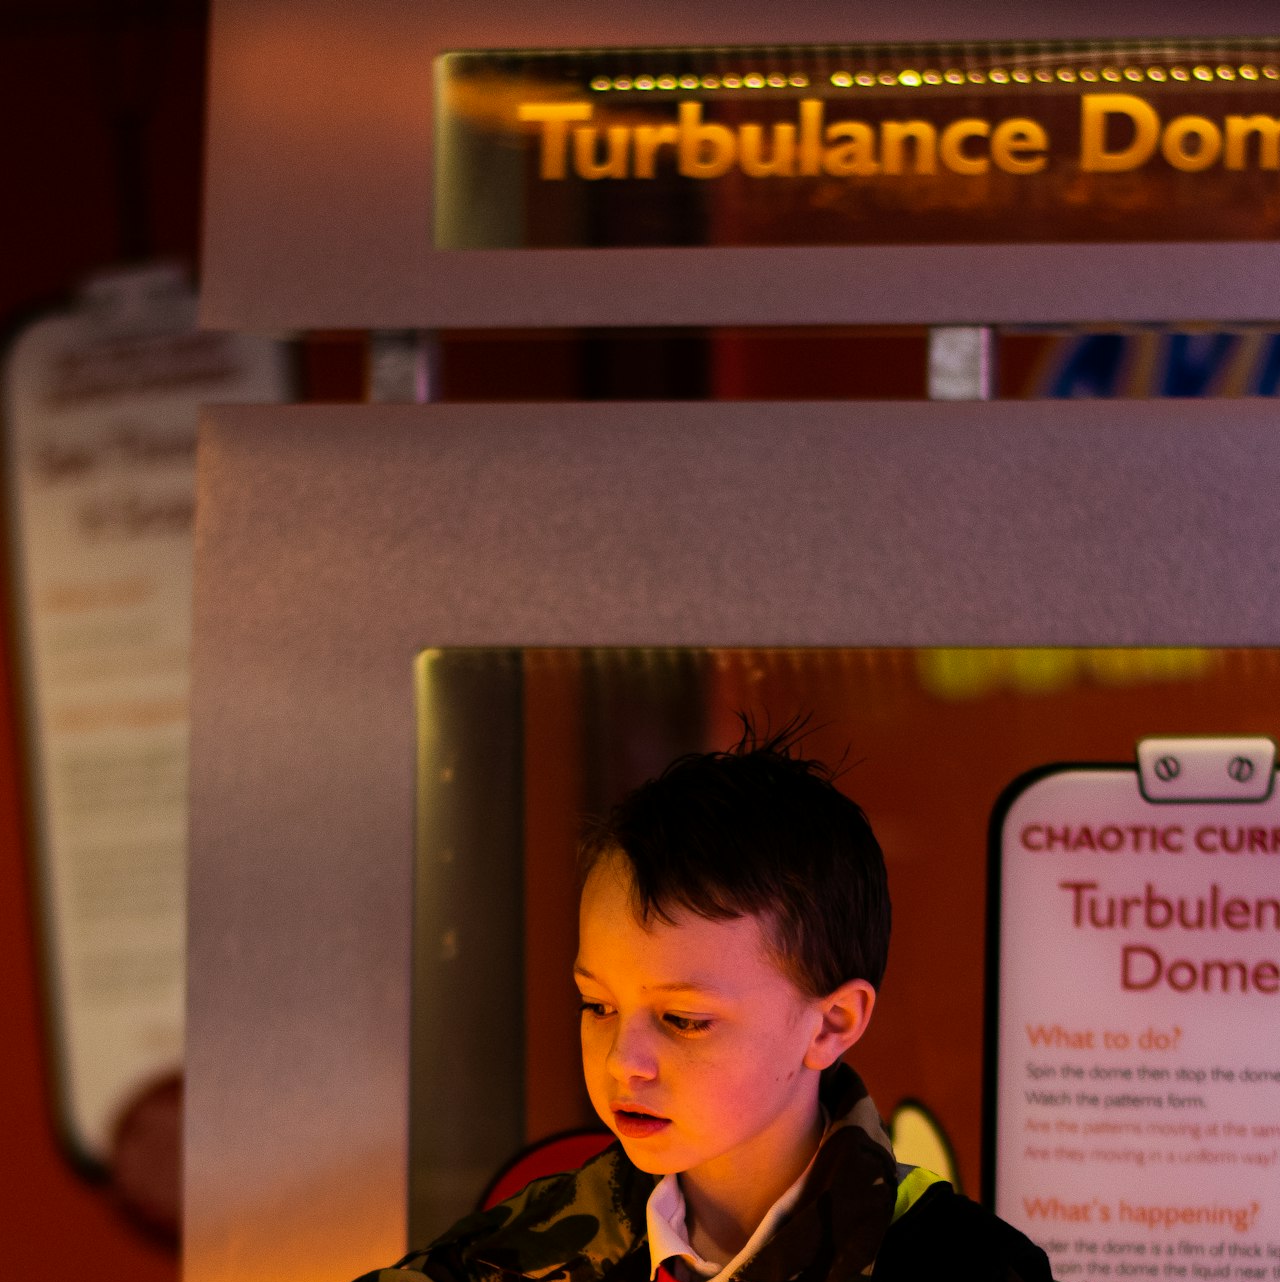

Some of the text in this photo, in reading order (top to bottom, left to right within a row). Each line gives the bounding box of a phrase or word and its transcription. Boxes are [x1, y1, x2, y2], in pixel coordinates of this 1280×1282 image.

[519, 97, 1049, 182] Turbulance
[1020, 824, 1184, 853] CHAOTIC
[1024, 1024, 1183, 1051] What to do?
[1025, 1063, 1056, 1082] Spin
[1060, 1063, 1085, 1079] the
[1088, 1064, 1133, 1080] dome
[1136, 1065, 1170, 1081] then
[1175, 1065, 1207, 1084] stop
[1210, 1066, 1235, 1081] the
[1075, 1092, 1099, 1107] the
[1103, 1092, 1164, 1109] patterns
[1055, 1119, 1079, 1134] the
[1083, 1120, 1142, 1137] patterns
[1145, 1122, 1202, 1141] moving
[1222, 1121, 1247, 1137] the
[1023, 1197, 1261, 1233] What's happening?
[1074, 1240, 1098, 1254] the
[1102, 1241, 1147, 1255] dome
[1151, 1241, 1161, 1255] is
[1165, 1243, 1175, 1255] a
[1177, 1241, 1205, 1256] film
[1208, 1241, 1226, 1256] of
[1228, 1241, 1262, 1257] thick
[1055, 1262, 1082, 1277] spin
[1086, 1261, 1111, 1276] the
[1115, 1262, 1160, 1278] dome
[1163, 1263, 1188, 1278] the
[1192, 1263, 1231, 1282] liquid
[1234, 1268, 1267, 1280] near
